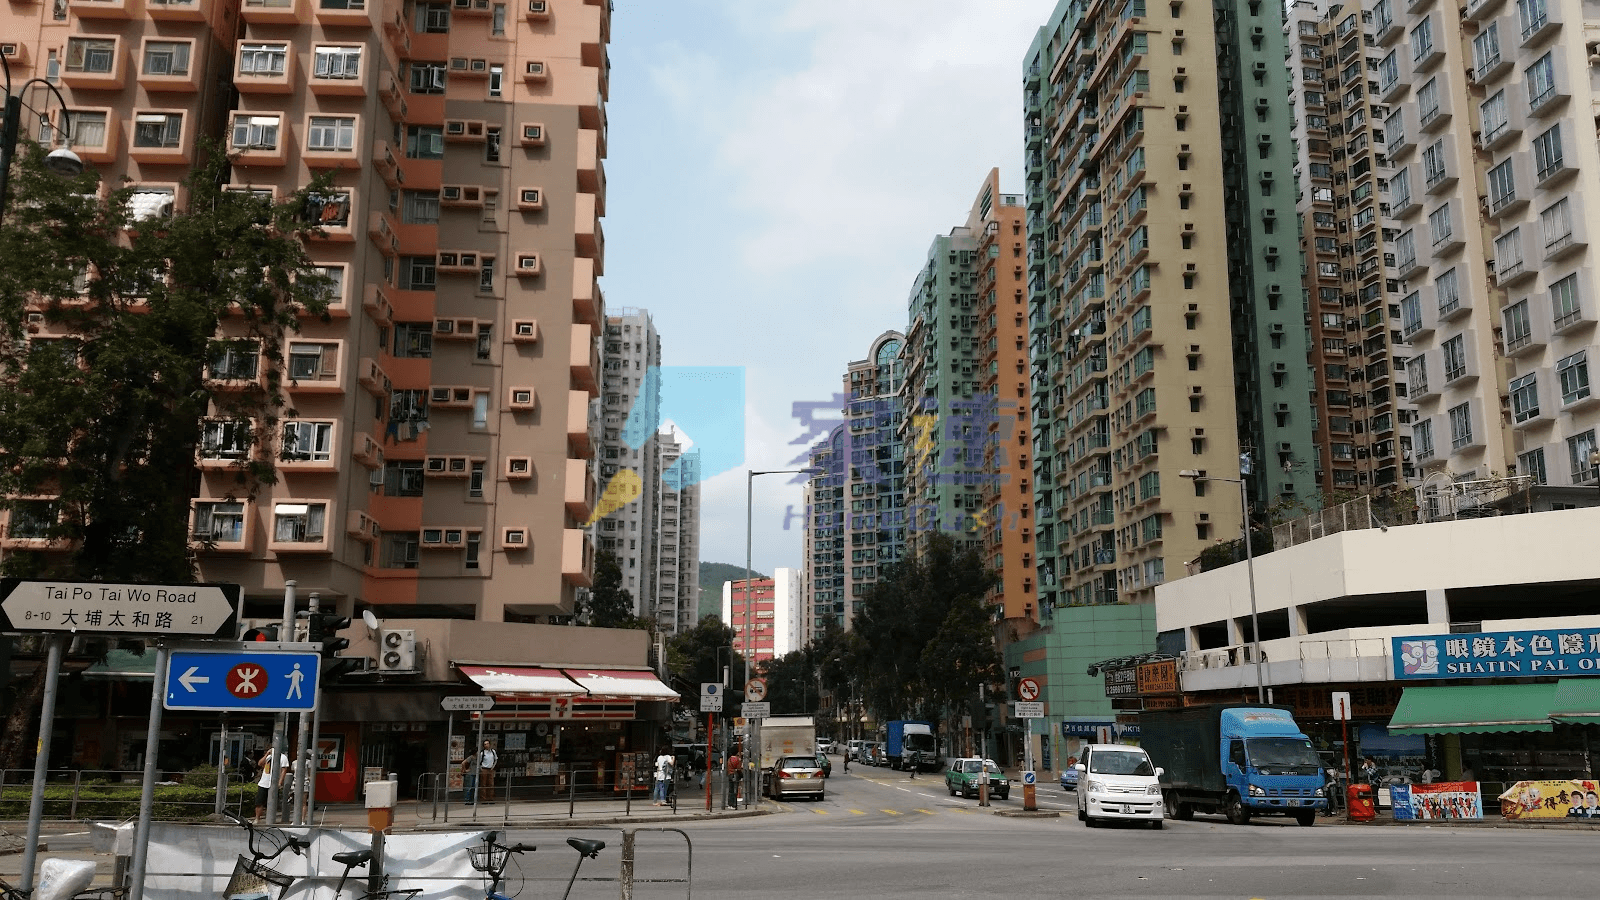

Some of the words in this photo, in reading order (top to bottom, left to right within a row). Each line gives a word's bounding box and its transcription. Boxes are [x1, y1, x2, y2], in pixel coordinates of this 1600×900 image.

[45, 586, 67, 600] Tai
[73, 587, 92, 600] Po
[100, 588, 121, 601] Tai
[128, 589, 150, 602] Wo
[156, 590, 197, 603] Road
[25, 610, 51, 621] 8-10
[61, 608, 173, 629] 大埔太和路
[191, 615, 204, 625] 21
[1447, 660, 1521, 674] SHATIN
[1531, 659, 1569, 671] PAL
[317, 740, 337, 768] 7
